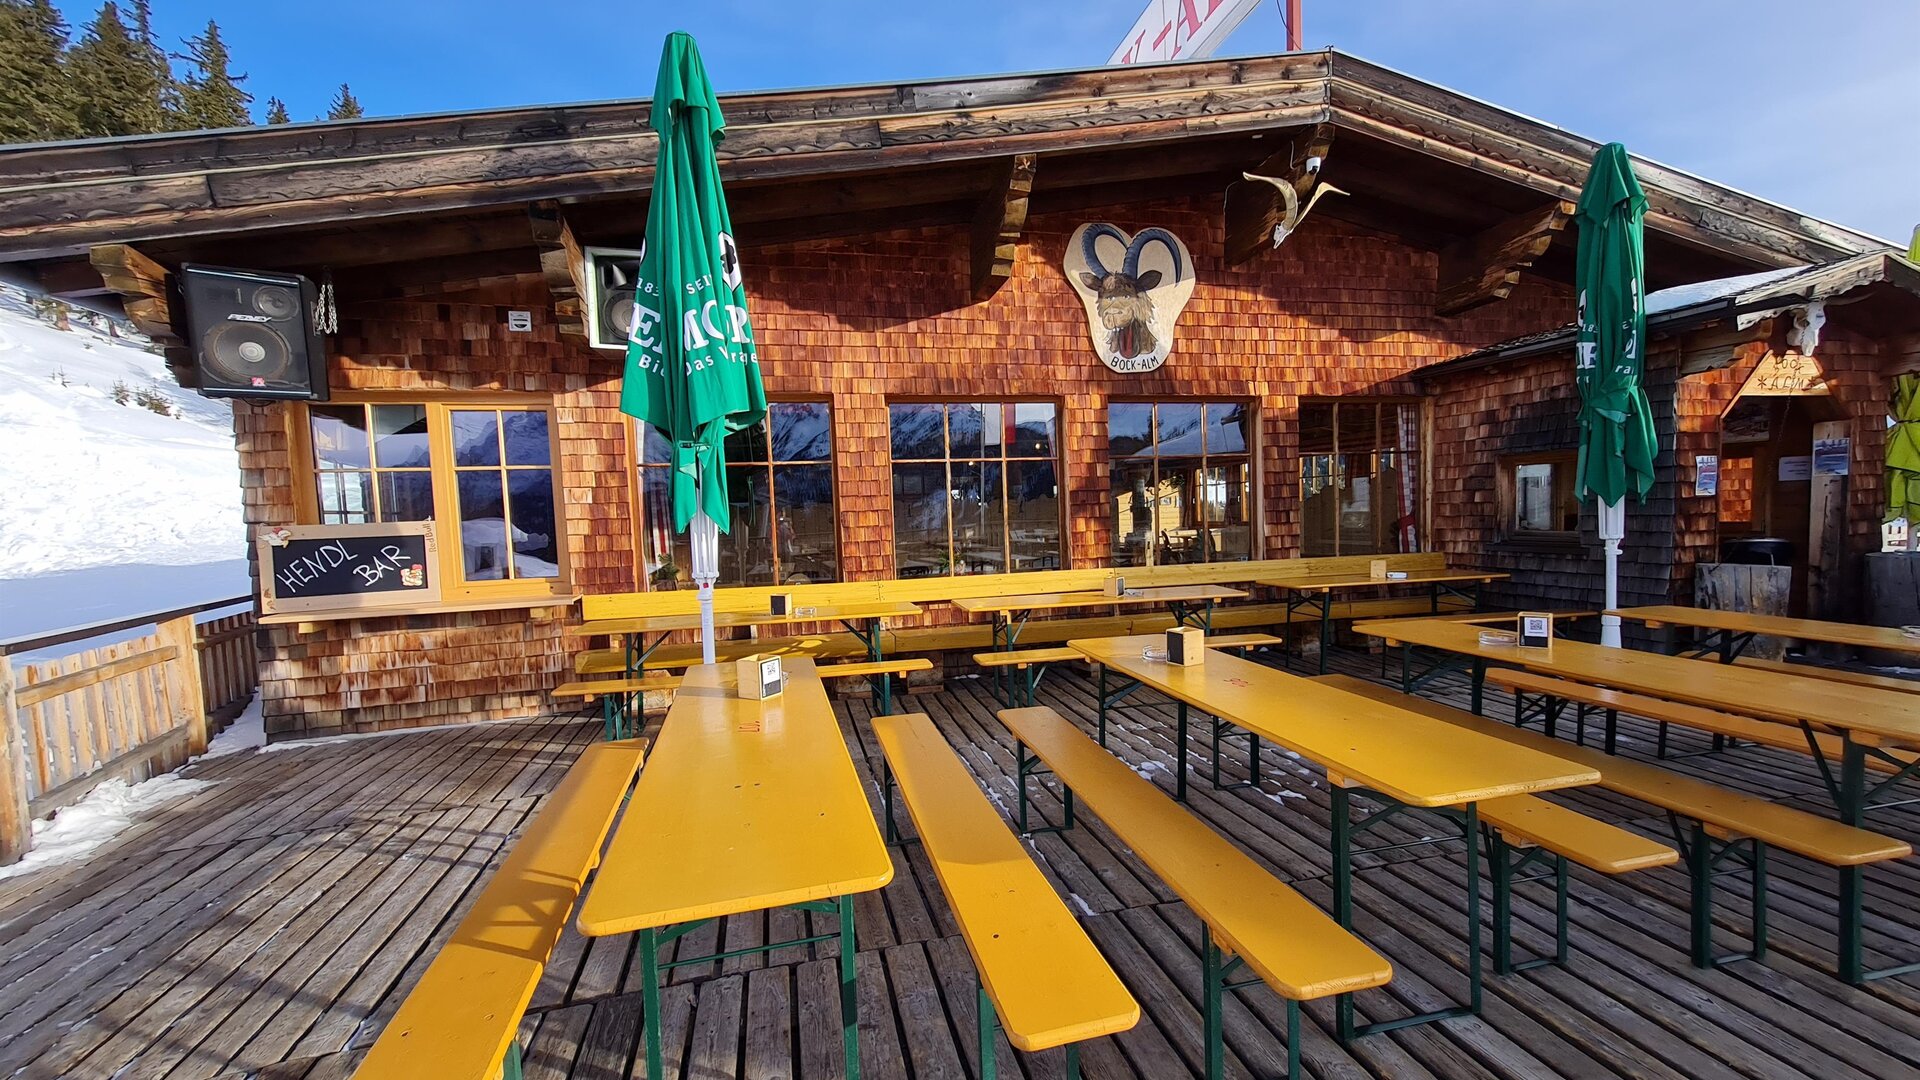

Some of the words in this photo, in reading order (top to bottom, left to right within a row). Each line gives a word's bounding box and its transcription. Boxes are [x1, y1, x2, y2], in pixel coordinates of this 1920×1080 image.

[1110, 356, 1160, 371] BOCK-ALM
[276, 540, 359, 593] HENDL
[352, 545, 411, 587] BAR
